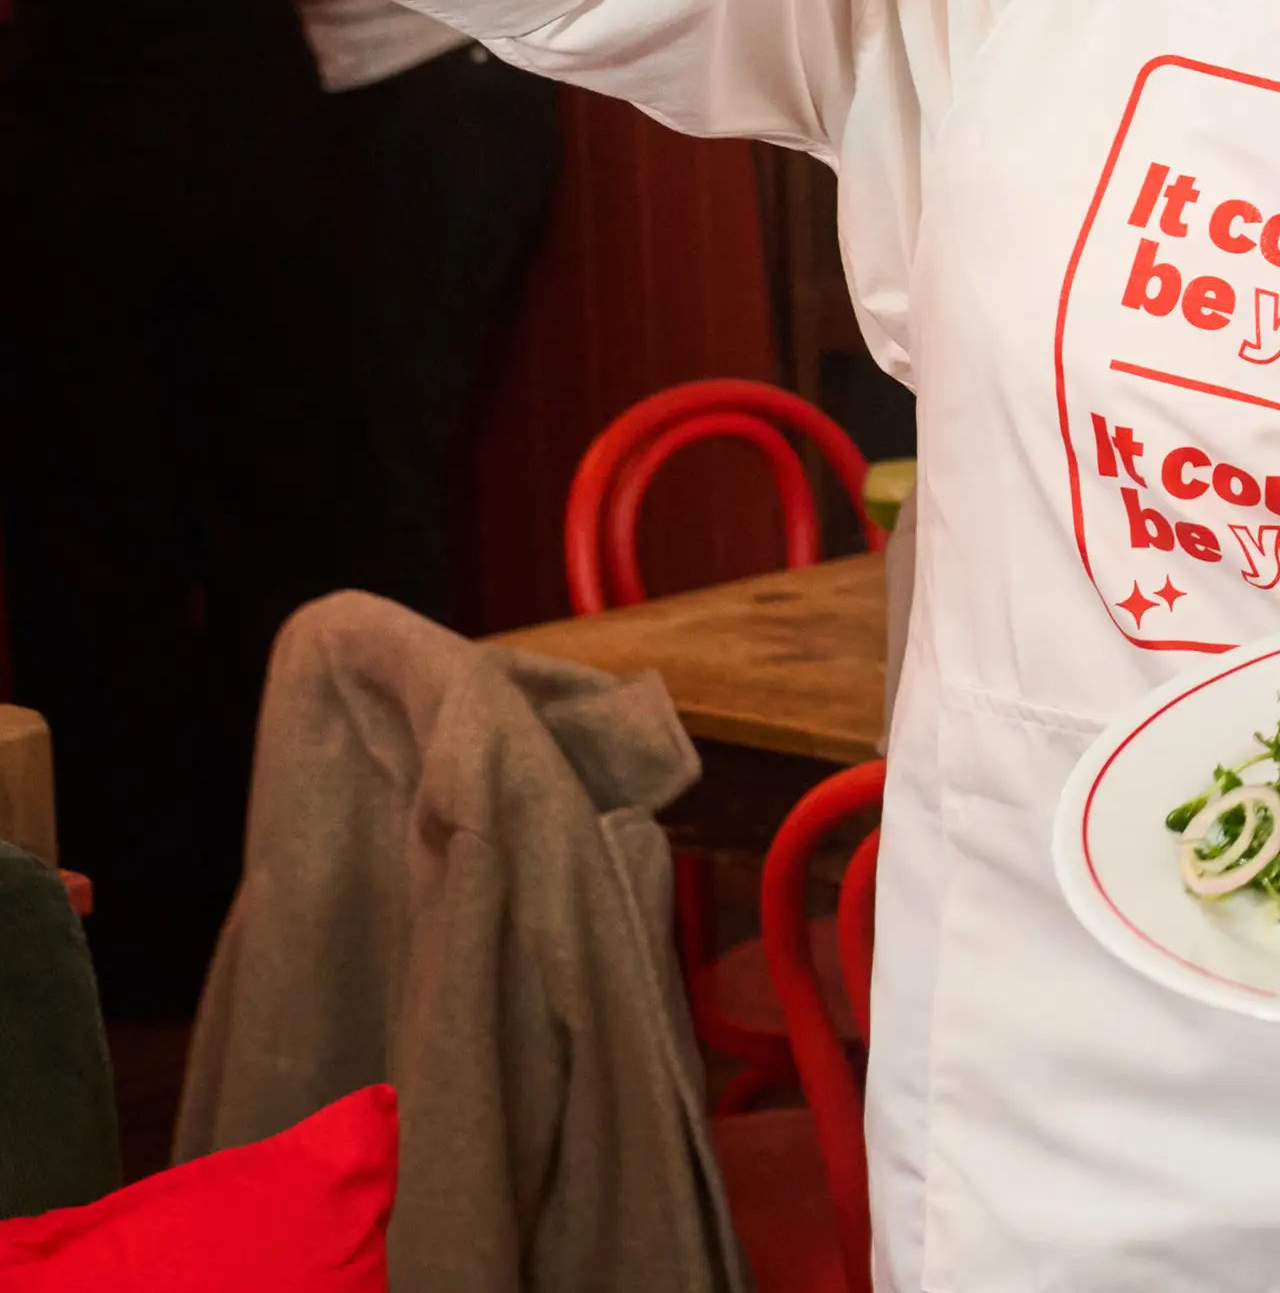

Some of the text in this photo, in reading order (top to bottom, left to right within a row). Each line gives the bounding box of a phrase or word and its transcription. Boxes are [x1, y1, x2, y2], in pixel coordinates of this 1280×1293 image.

[1127, 161, 1201, 239] It
[1120, 237, 1237, 332] be
[1090, 411, 1148, 489] It
[1119, 486, 1223, 563] be
